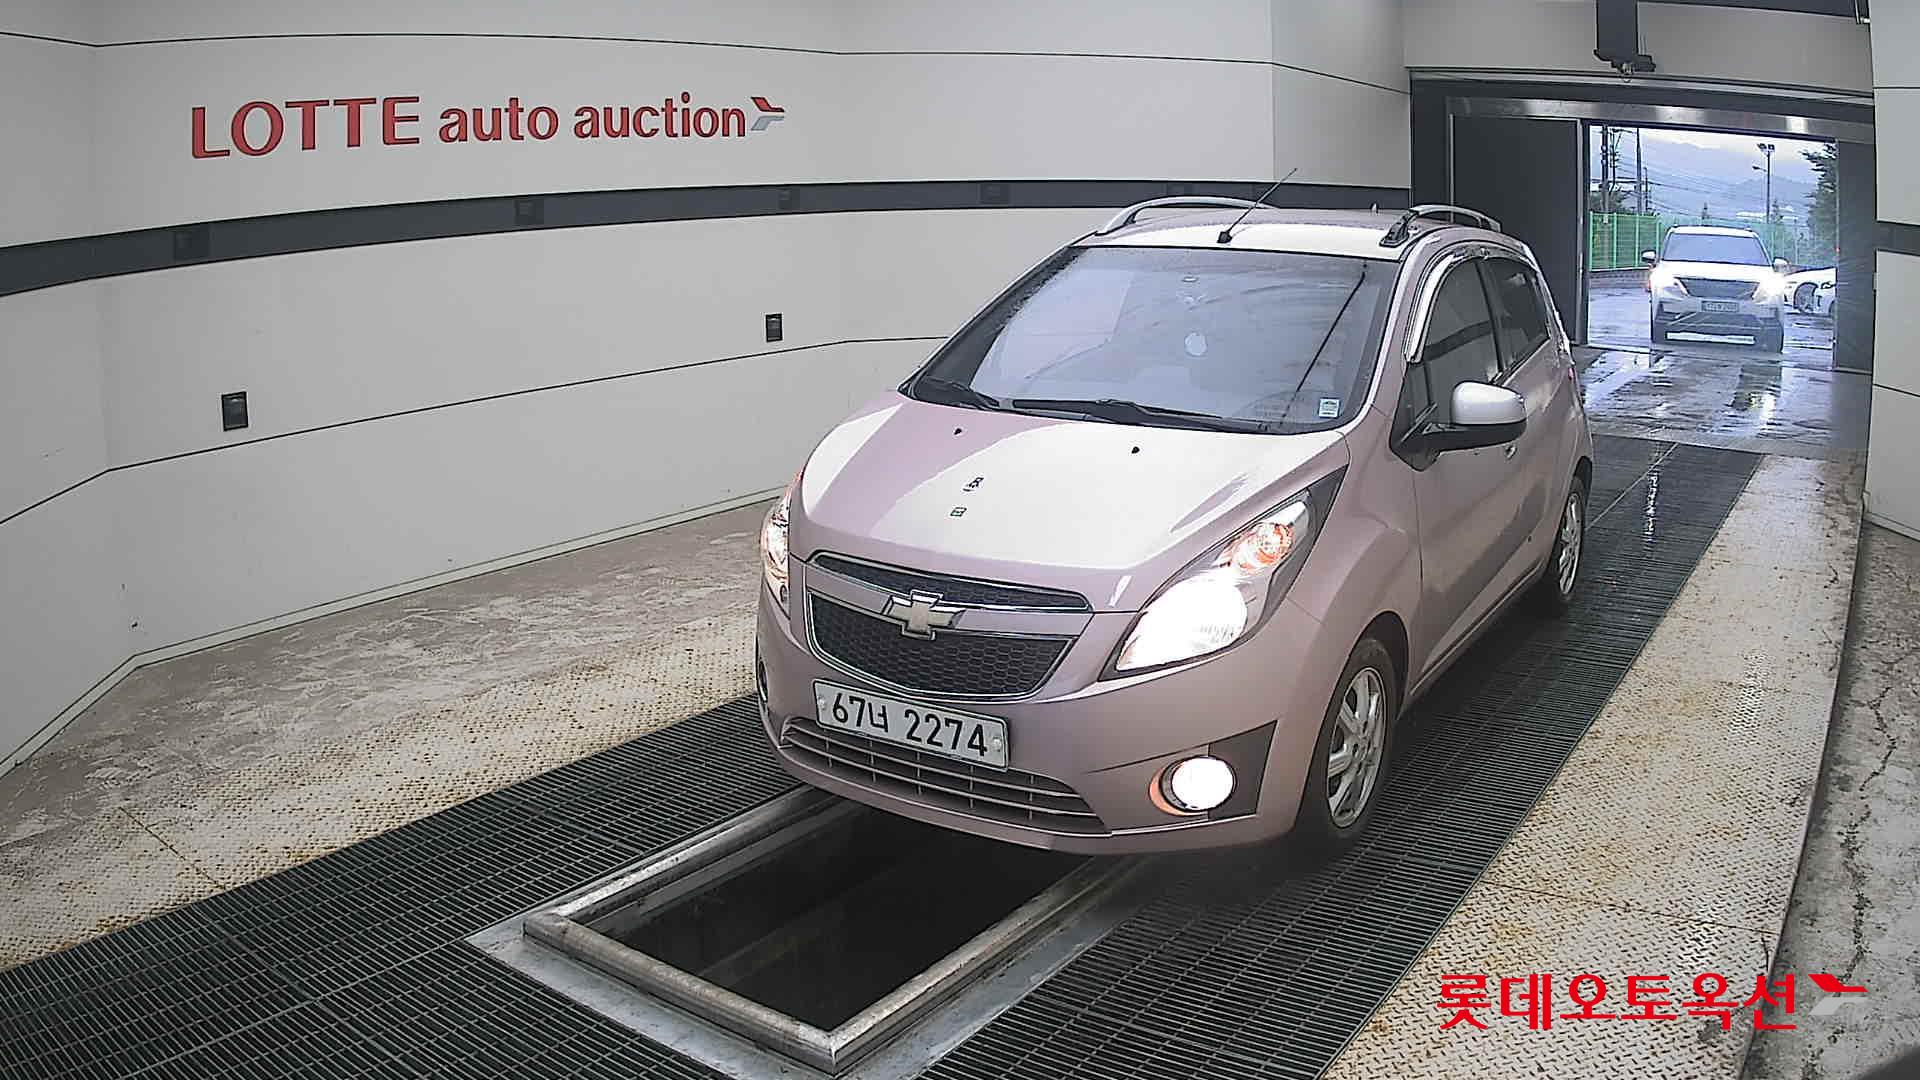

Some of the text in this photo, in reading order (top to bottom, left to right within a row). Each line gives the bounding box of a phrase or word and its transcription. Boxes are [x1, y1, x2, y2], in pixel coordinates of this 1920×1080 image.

[191, 91, 747, 159] LOTTE auto auction
[832, 692, 988, 757] 67너 2274
